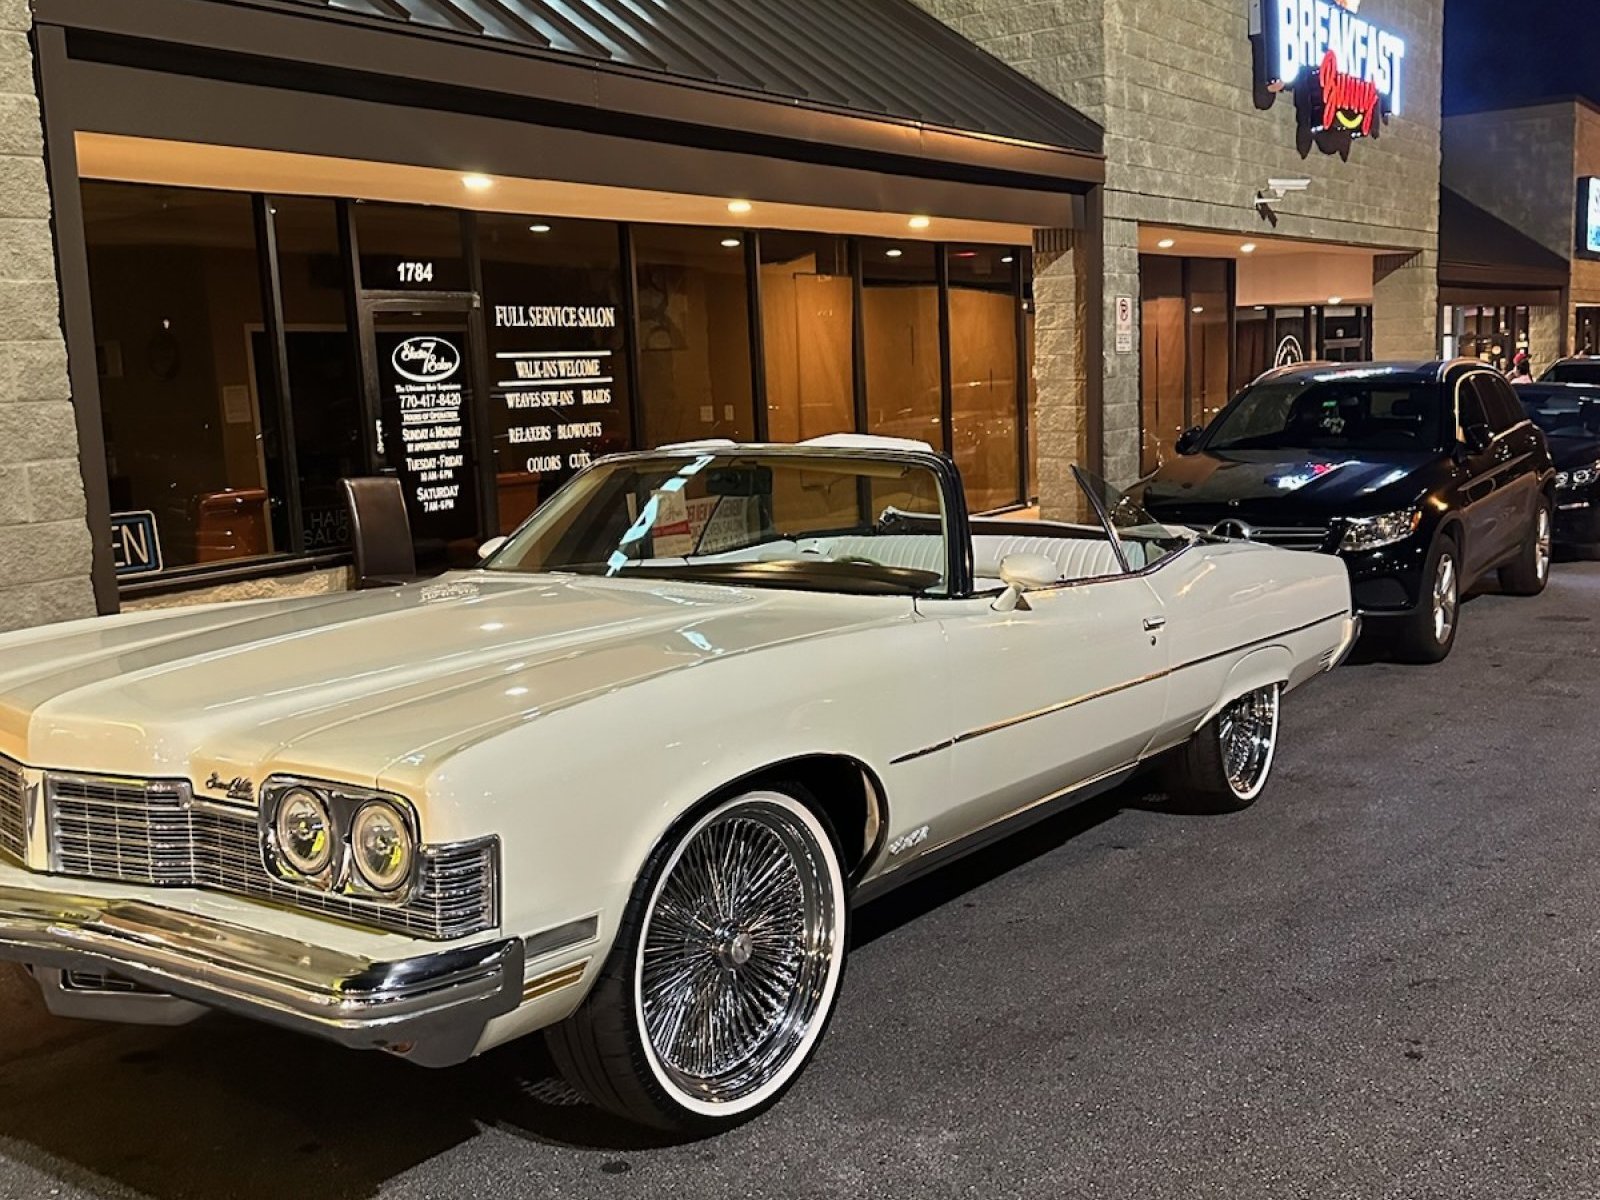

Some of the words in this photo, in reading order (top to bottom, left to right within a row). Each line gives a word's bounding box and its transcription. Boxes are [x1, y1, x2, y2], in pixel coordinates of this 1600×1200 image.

[1279, 0, 1405, 116] BREAKFAST
[397, 262, 433, 282] 1784
[495, 305, 528, 327] FULL
[528, 306, 577, 327] SERVICE
[577, 306, 615, 327] SALON
[421, 342, 437, 374] 7
[515, 360, 558, 378] WALK-INS
[558, 359, 600, 377] WELCOME
[505, 392, 540, 409] WEAVES
[541, 390, 575, 407] SEW-INS
[581, 388, 611, 405] BRAIDS
[402, 427, 429, 441] SUNDAY
[435, 425, 462, 438] MONDAY
[508, 426, 551, 443] RELAXERS
[557, 422, 602, 439] BLOWOUTS
[527, 456, 561, 473] COLORS
[568, 452, 591, 469] CUTS
[416, 486, 459, 501] SATURDAY
[304, 527, 349, 546] SALO
